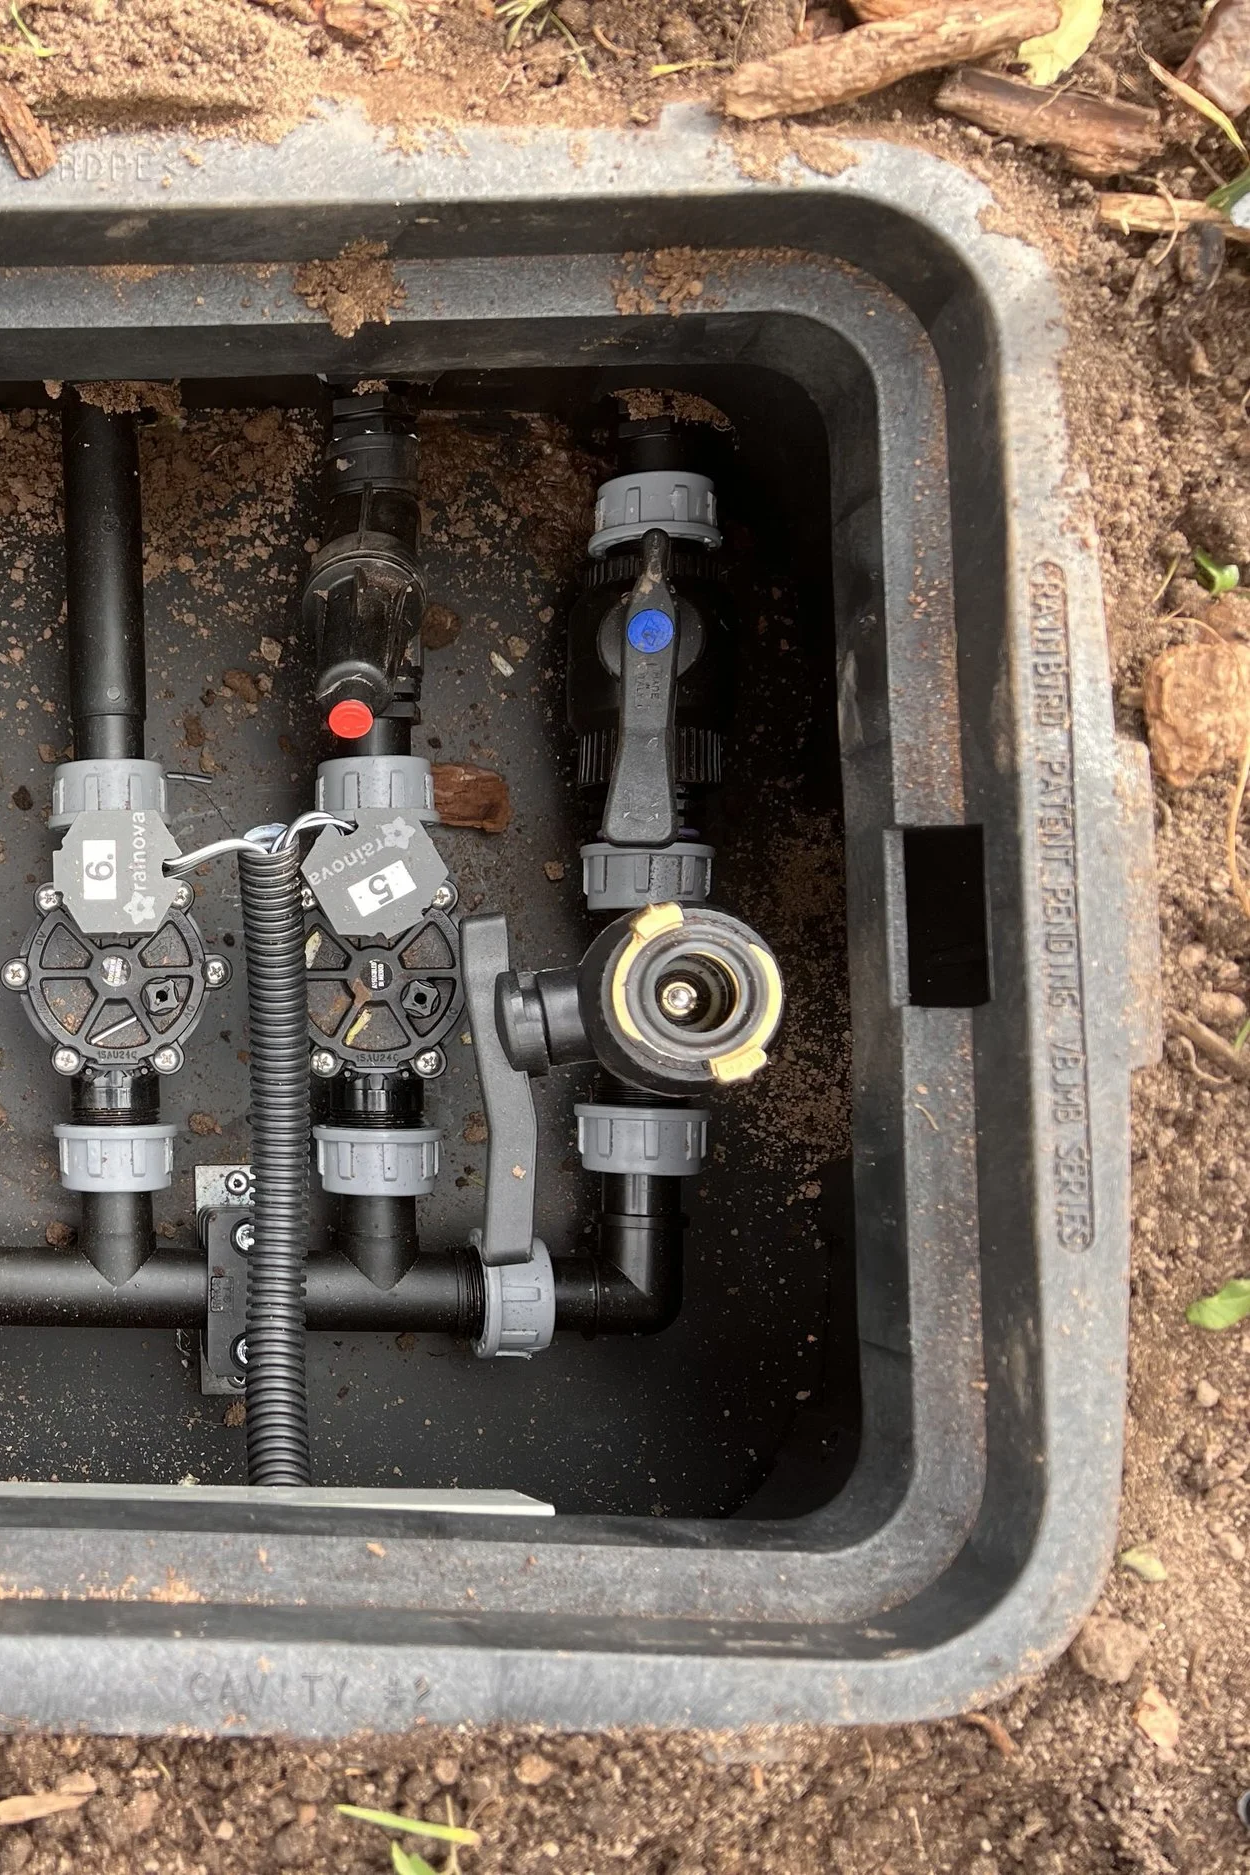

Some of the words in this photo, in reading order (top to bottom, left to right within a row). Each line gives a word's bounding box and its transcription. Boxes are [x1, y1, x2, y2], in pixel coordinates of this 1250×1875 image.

[129, 811, 147, 891] rainova
[1039, 760, 1073, 867] PATENT
[308, 838, 385, 886] rainova
[368, 874, 394, 905] 5
[1043, 887, 1079, 1008] PENDING
[1055, 1144, 1092, 1244] SERIES
[189, 1671, 349, 1706] CAVITY
